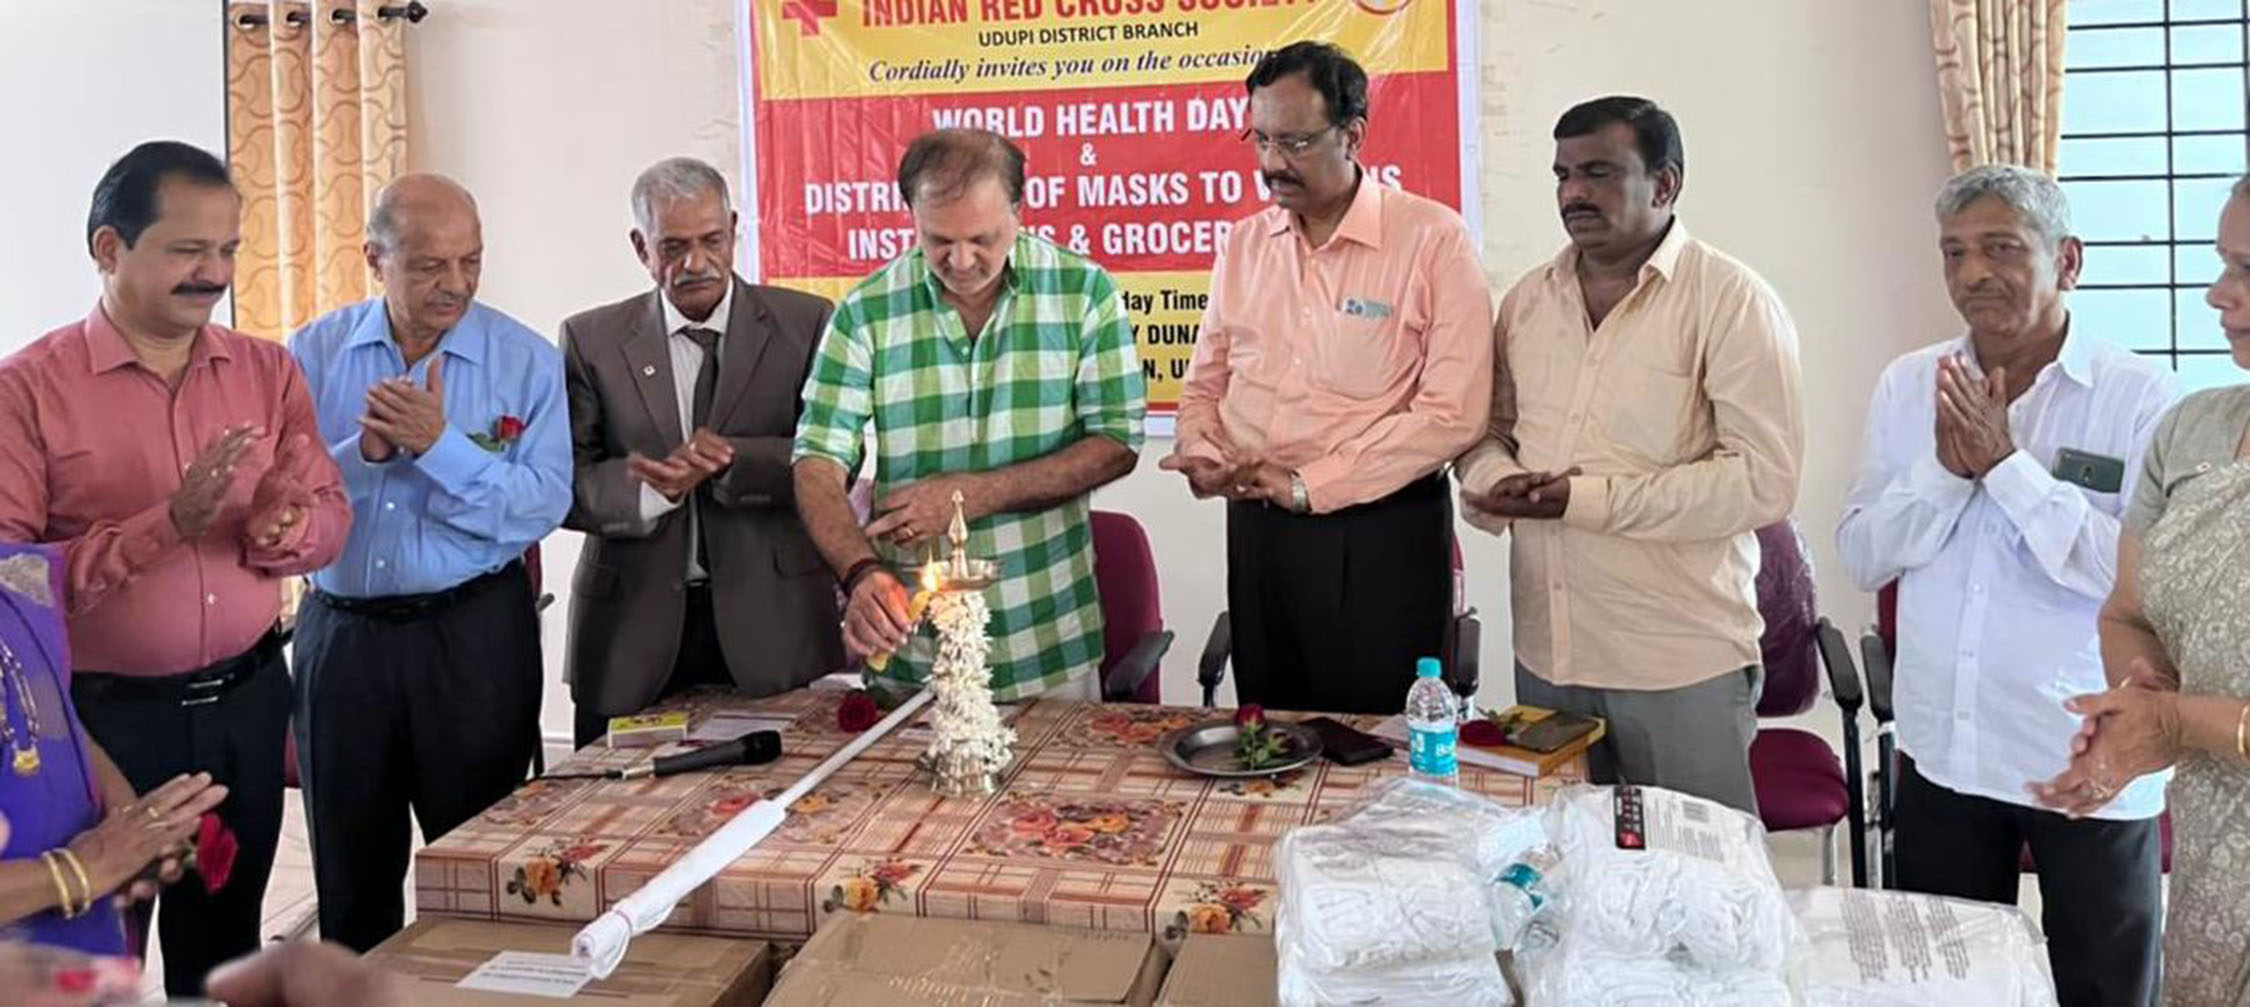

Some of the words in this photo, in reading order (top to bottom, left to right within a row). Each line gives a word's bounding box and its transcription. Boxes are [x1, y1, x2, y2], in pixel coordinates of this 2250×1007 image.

[863, 0, 969, 27] INDIAN
[981, 0, 1043, 21] RED
[978, 30, 1034, 47] UDUPI
[1039, 26, 1117, 44] DISTRICT
[1122, 21, 1198, 40] BRANCH
[869, 59, 970, 84] Cordially
[976, 56, 1047, 78] invites
[1051, 58, 1094, 81] you
[1101, 56, 1130, 73] on
[1137, 50, 1171, 71] the
[1178, 44, 1264, 69] occasio
[932, 106, 1044, 138] WORLD
[1056, 100, 1174, 136] HEALTH
[1186, 97, 1249, 131] DAY
[1080, 144, 1096, 166] &
[1026, 175, 1064, 209] OF
[1077, 172, 1189, 207] MASKS
[1200, 170, 1242, 204] TO
[1069, 224, 1091, 255] &
[1160, 289, 1208, 311] Time
